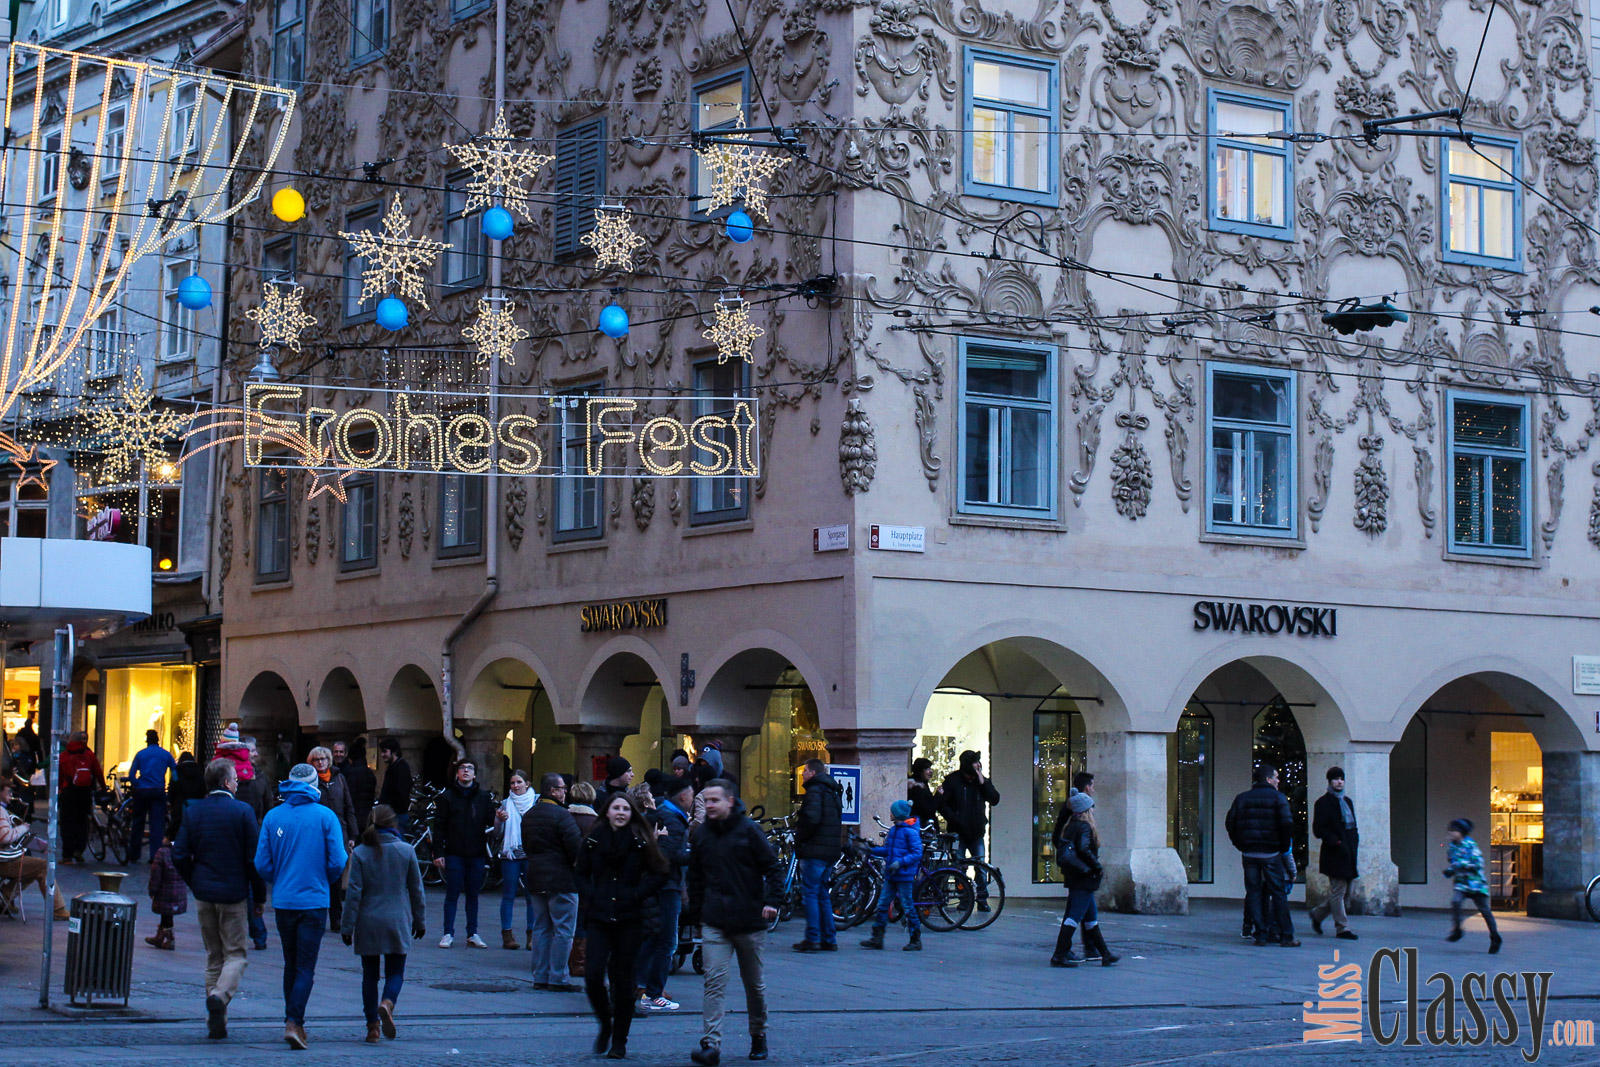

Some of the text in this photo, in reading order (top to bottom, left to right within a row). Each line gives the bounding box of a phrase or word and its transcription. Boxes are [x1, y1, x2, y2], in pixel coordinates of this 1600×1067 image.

[246, 384, 758, 476] Frohes Fest
[891, 530, 923, 542] Hauptplatz
[581, 599, 668, 632] SWAROVSKI
[1194, 601, 1337, 636] SWAROVSKI
[797, 741, 826, 751] SWAROVSK
